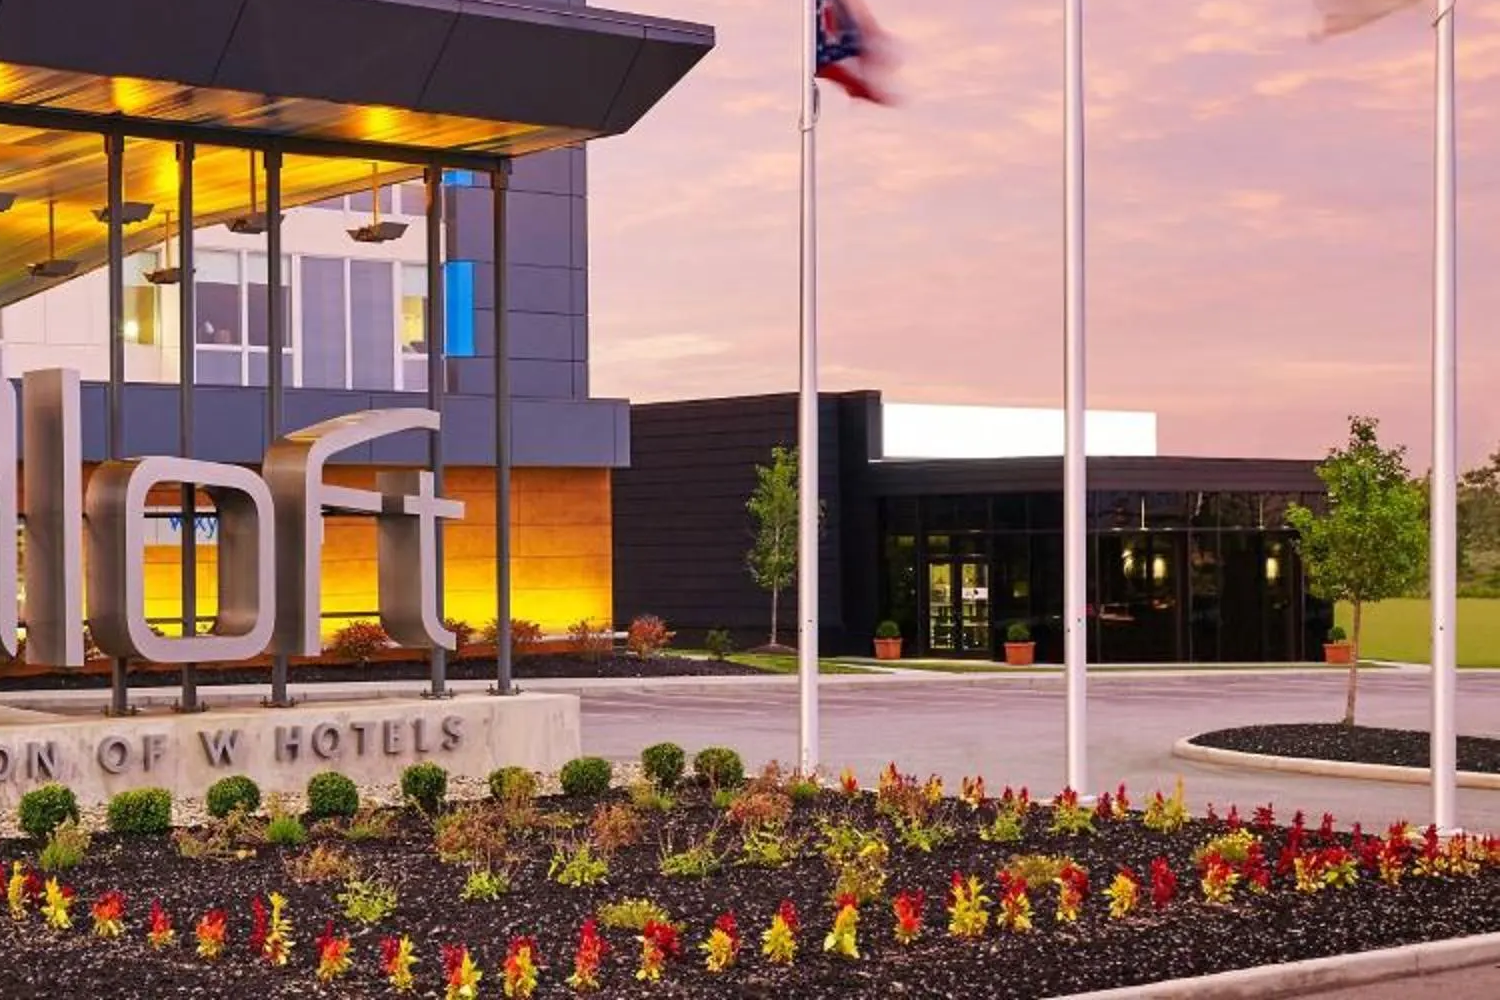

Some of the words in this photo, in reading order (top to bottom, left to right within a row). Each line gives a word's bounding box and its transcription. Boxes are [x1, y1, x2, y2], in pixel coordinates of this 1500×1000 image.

[96, 733, 167, 775] OF
[197, 728, 244, 767] W
[273, 713, 465, 764] HOTELS
